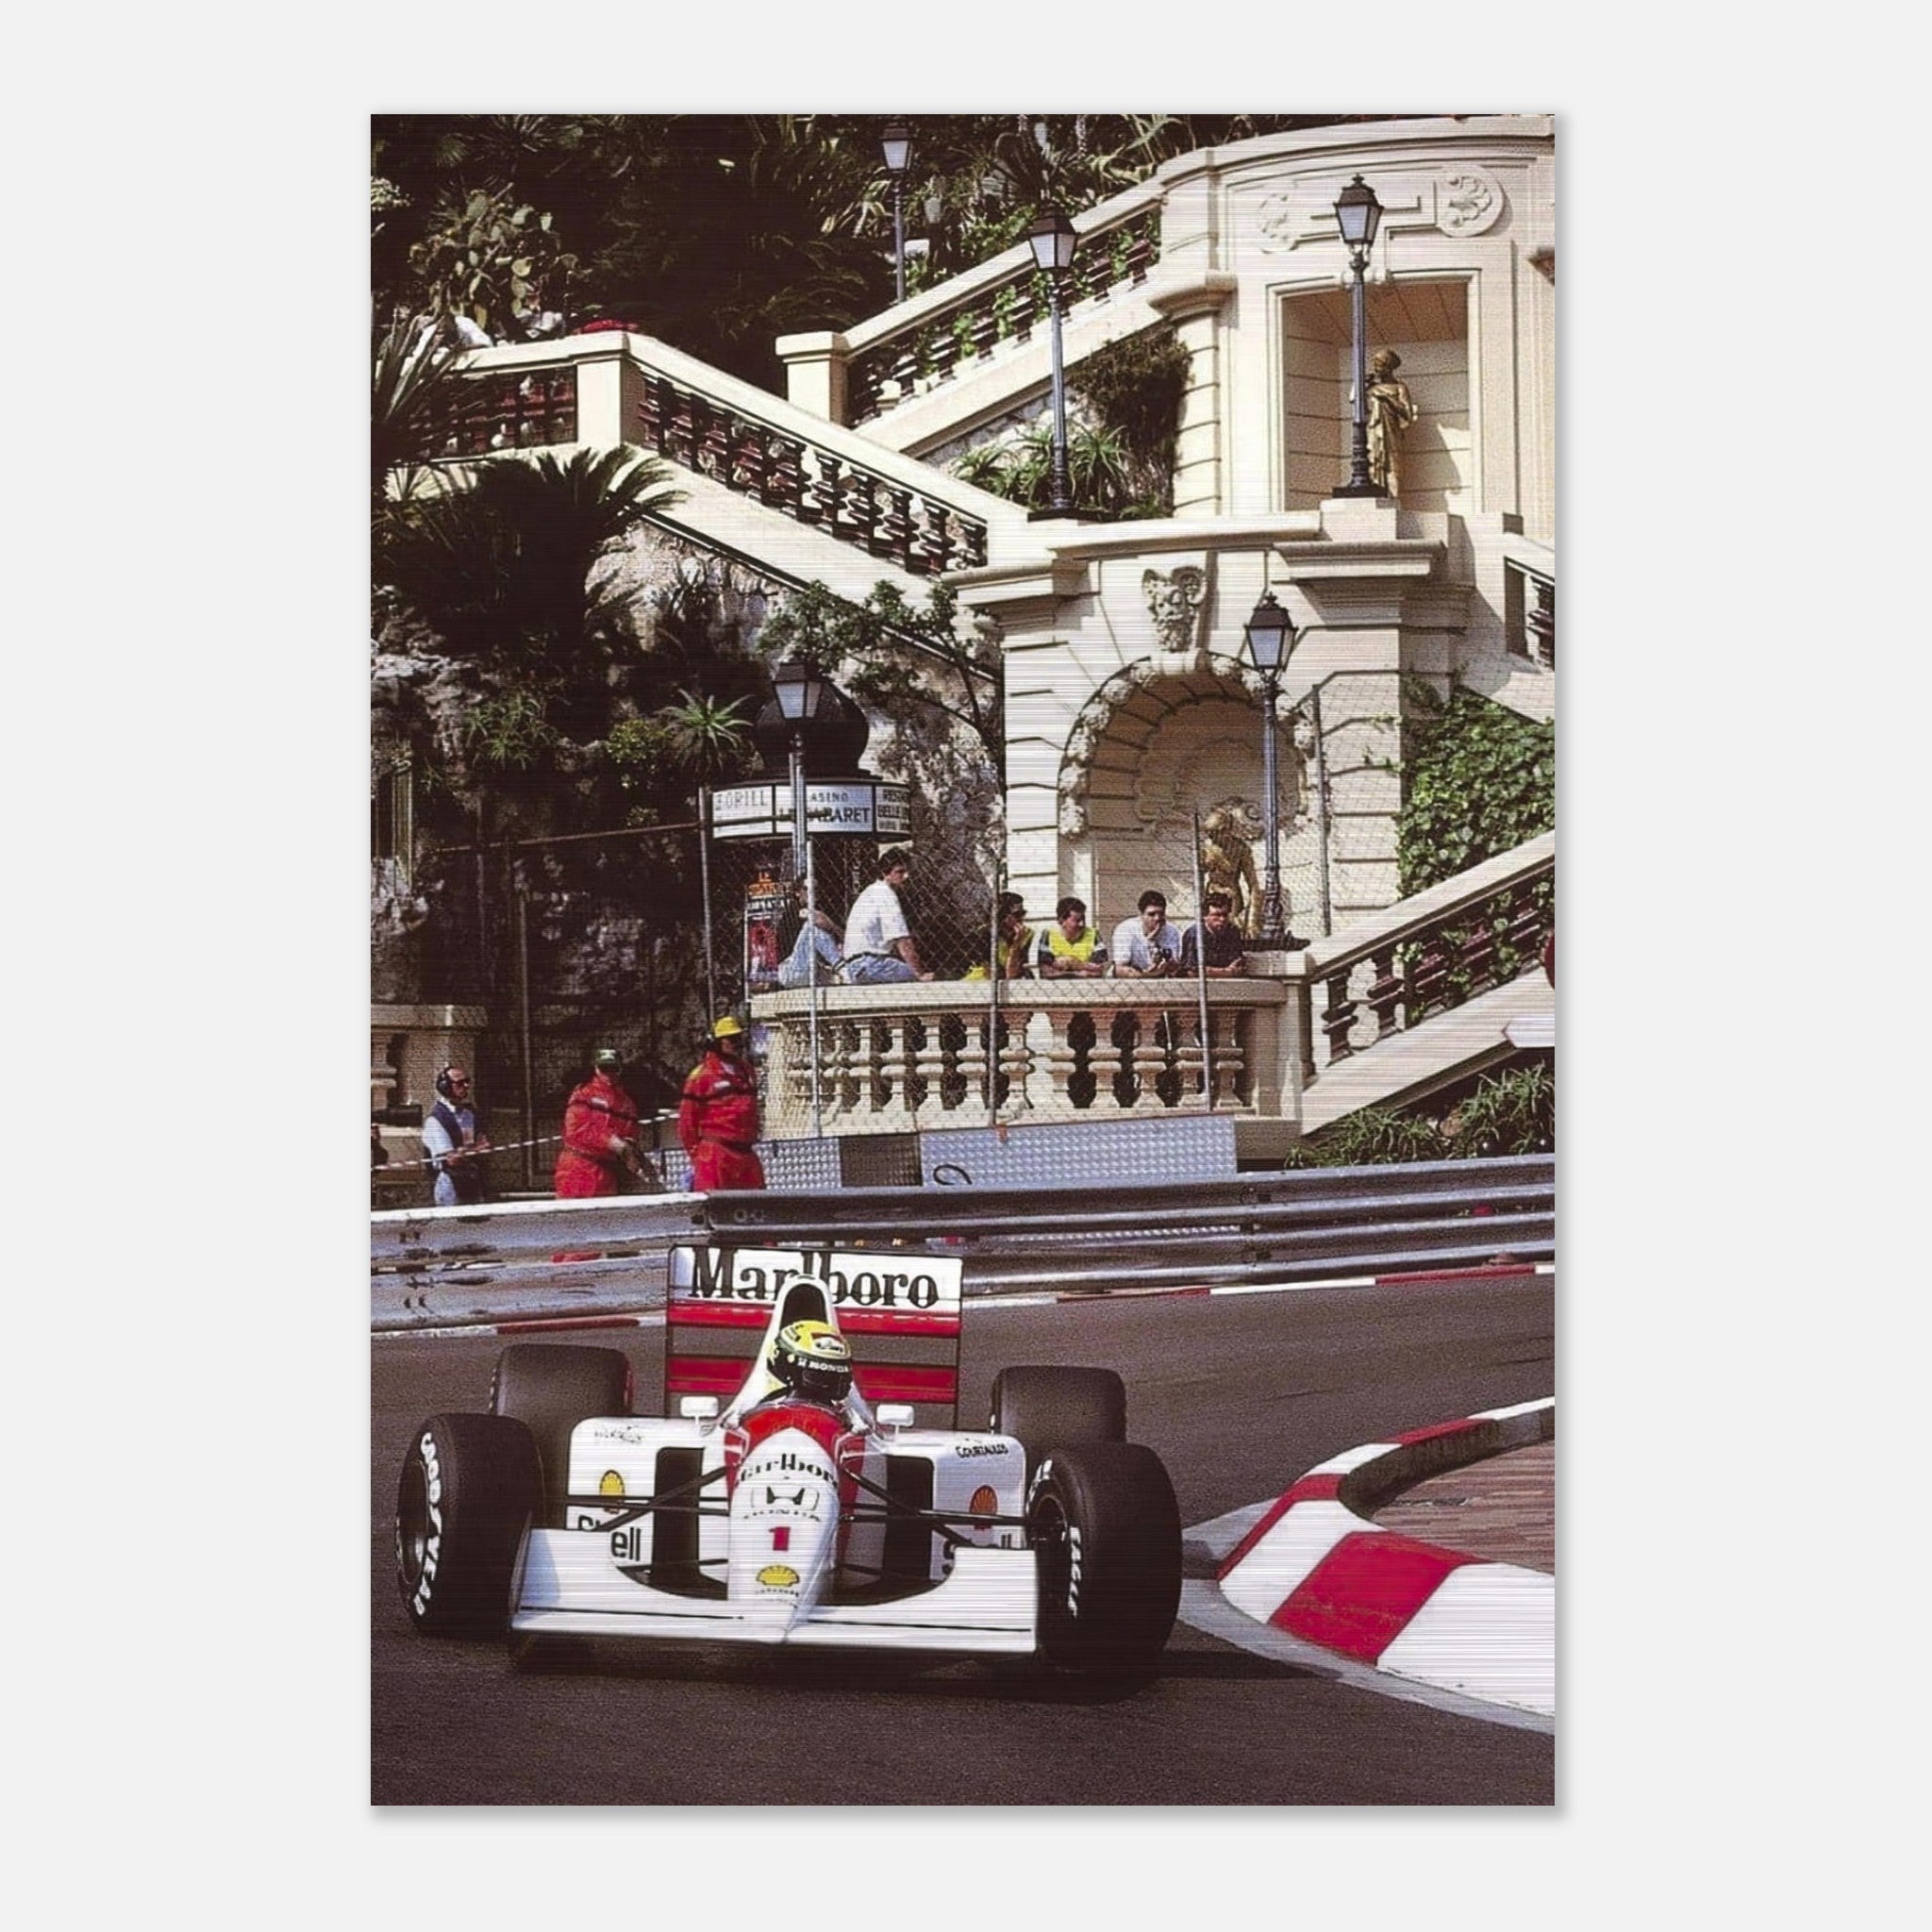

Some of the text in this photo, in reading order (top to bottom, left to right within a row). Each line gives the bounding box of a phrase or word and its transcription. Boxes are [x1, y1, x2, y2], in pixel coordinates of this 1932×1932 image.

[808, 791, 849, 803] ASINO
[737, 1453, 840, 1489] arlbor
[577, 1514, 641, 1562] ell
[769, 1525, 791, 1552] 1
